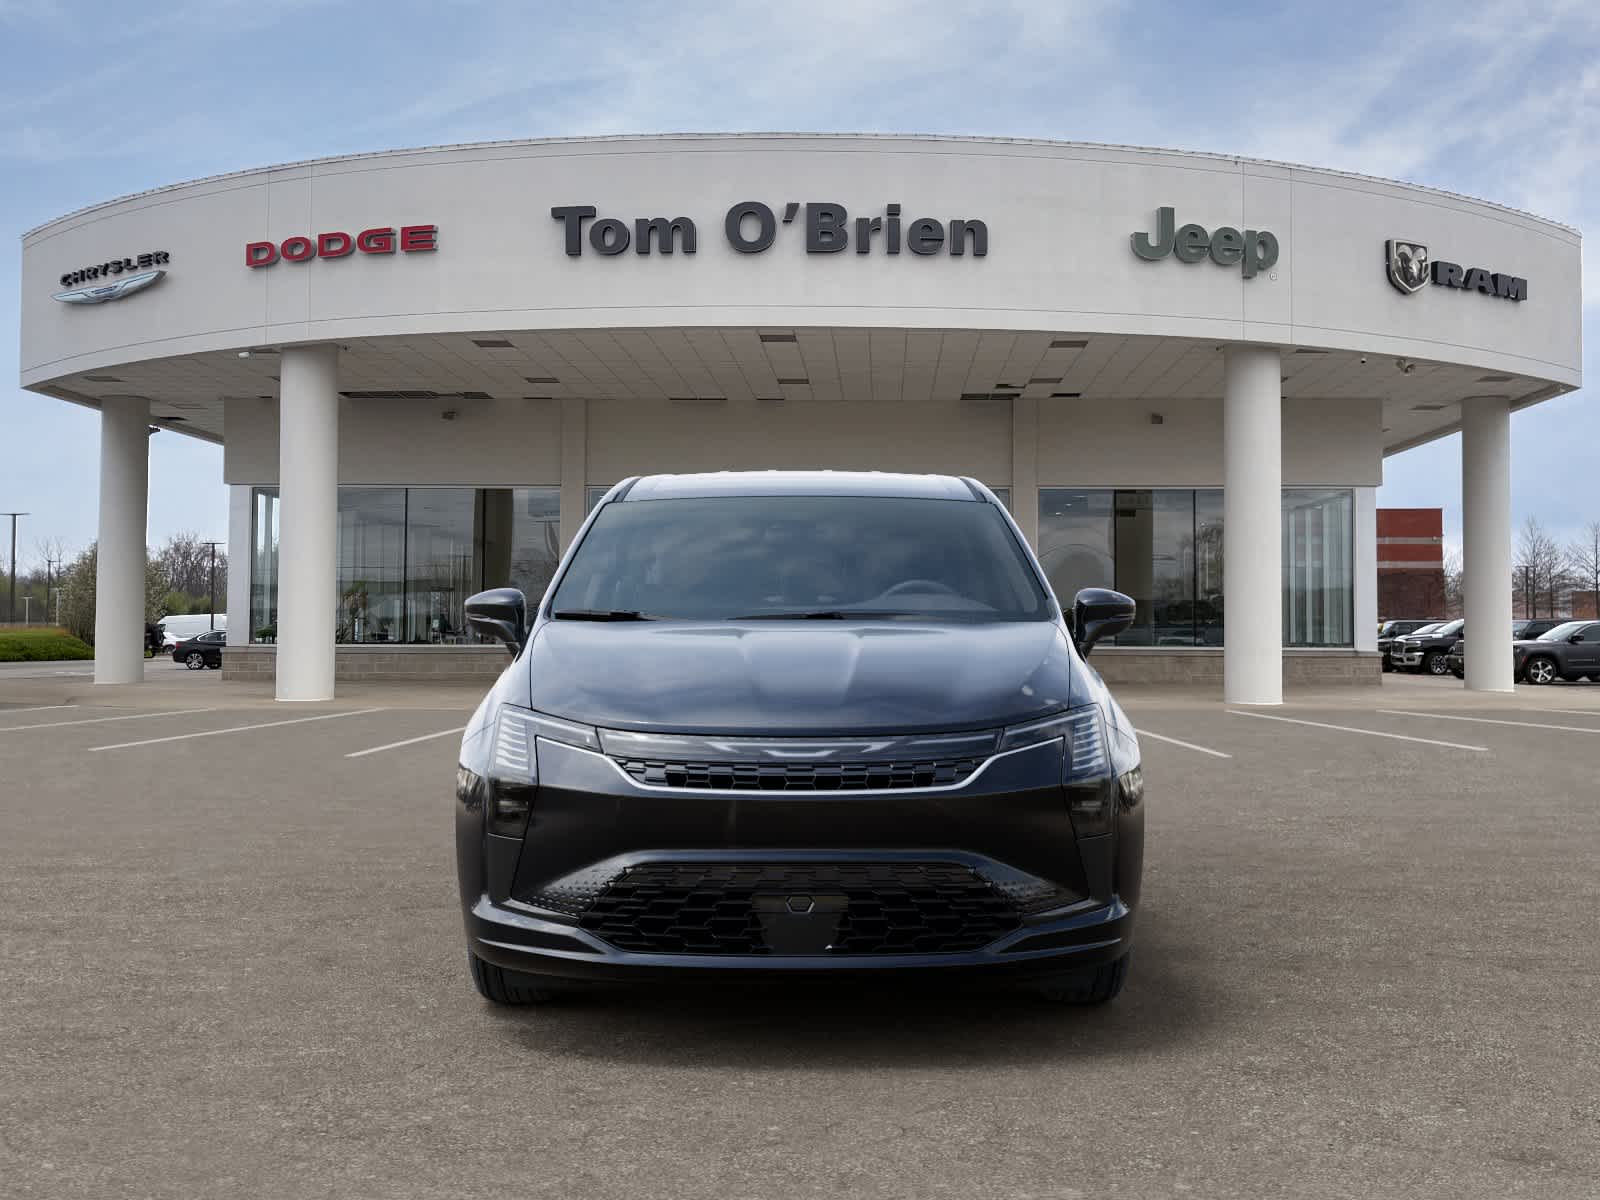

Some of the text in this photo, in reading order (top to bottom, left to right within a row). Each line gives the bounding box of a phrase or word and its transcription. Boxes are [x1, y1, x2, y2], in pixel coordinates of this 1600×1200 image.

[245, 224, 438, 268] DODGE
[551, 205, 697, 256] Tom
[60, 250, 170, 287] CHRYSLER
[1430, 260, 1527, 301] RAM
